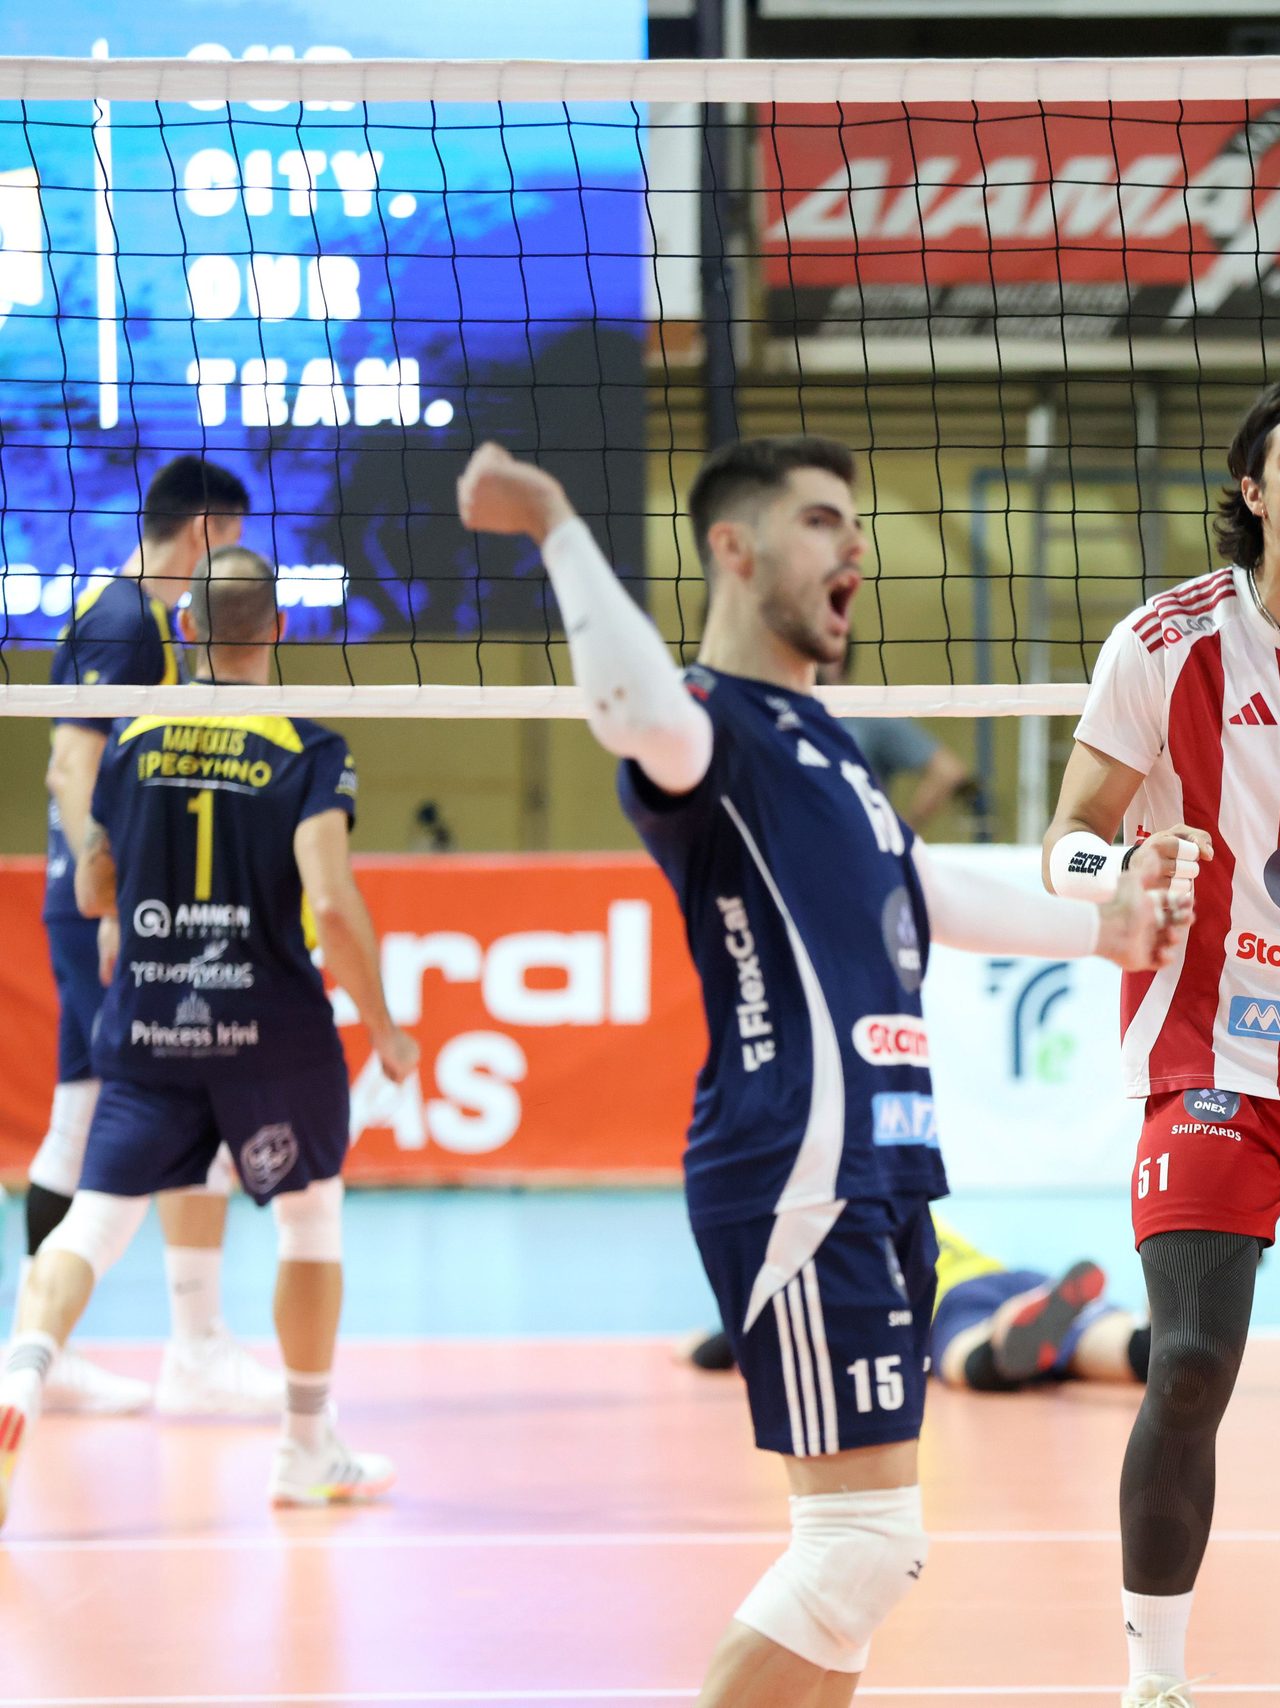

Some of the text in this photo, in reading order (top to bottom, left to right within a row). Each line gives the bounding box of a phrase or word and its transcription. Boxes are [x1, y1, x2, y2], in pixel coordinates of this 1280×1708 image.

[184, 149, 417, 219] CITY.
[186, 255, 362, 322] OUR
[187, 358, 454, 427] TEAM.
[187, 790, 214, 901] 1
[1171, 1124, 1242, 1142] SHIPYARDS
[1193, 1101, 1227, 1115] ONEX
[1137, 1152, 1170, 1200] 51
[846, 1354, 905, 1414] 15
